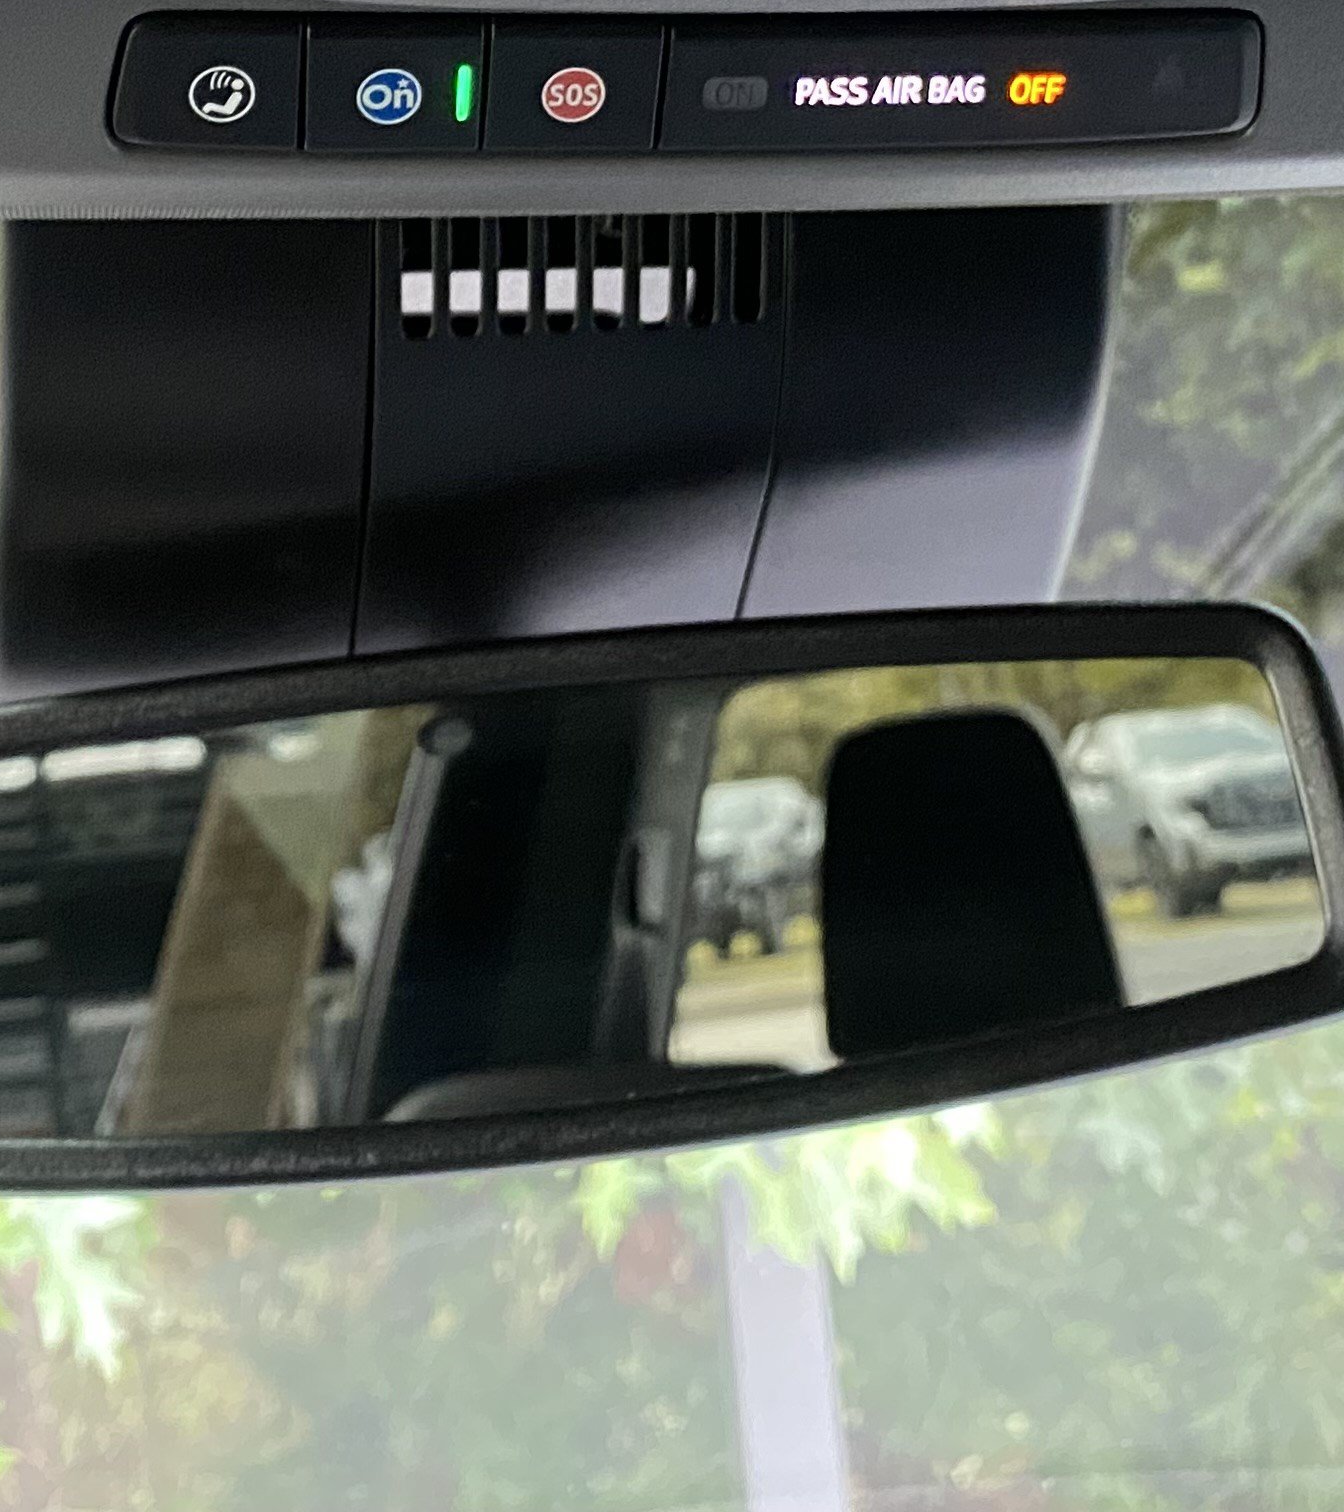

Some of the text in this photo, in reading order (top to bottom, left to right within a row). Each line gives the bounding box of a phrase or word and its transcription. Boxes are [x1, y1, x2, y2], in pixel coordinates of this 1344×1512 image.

[362, 81, 415, 110] On
[548, 85, 600, 108] SOS
[714, 75, 1066, 106] ON PASS AIR BAG OFF
